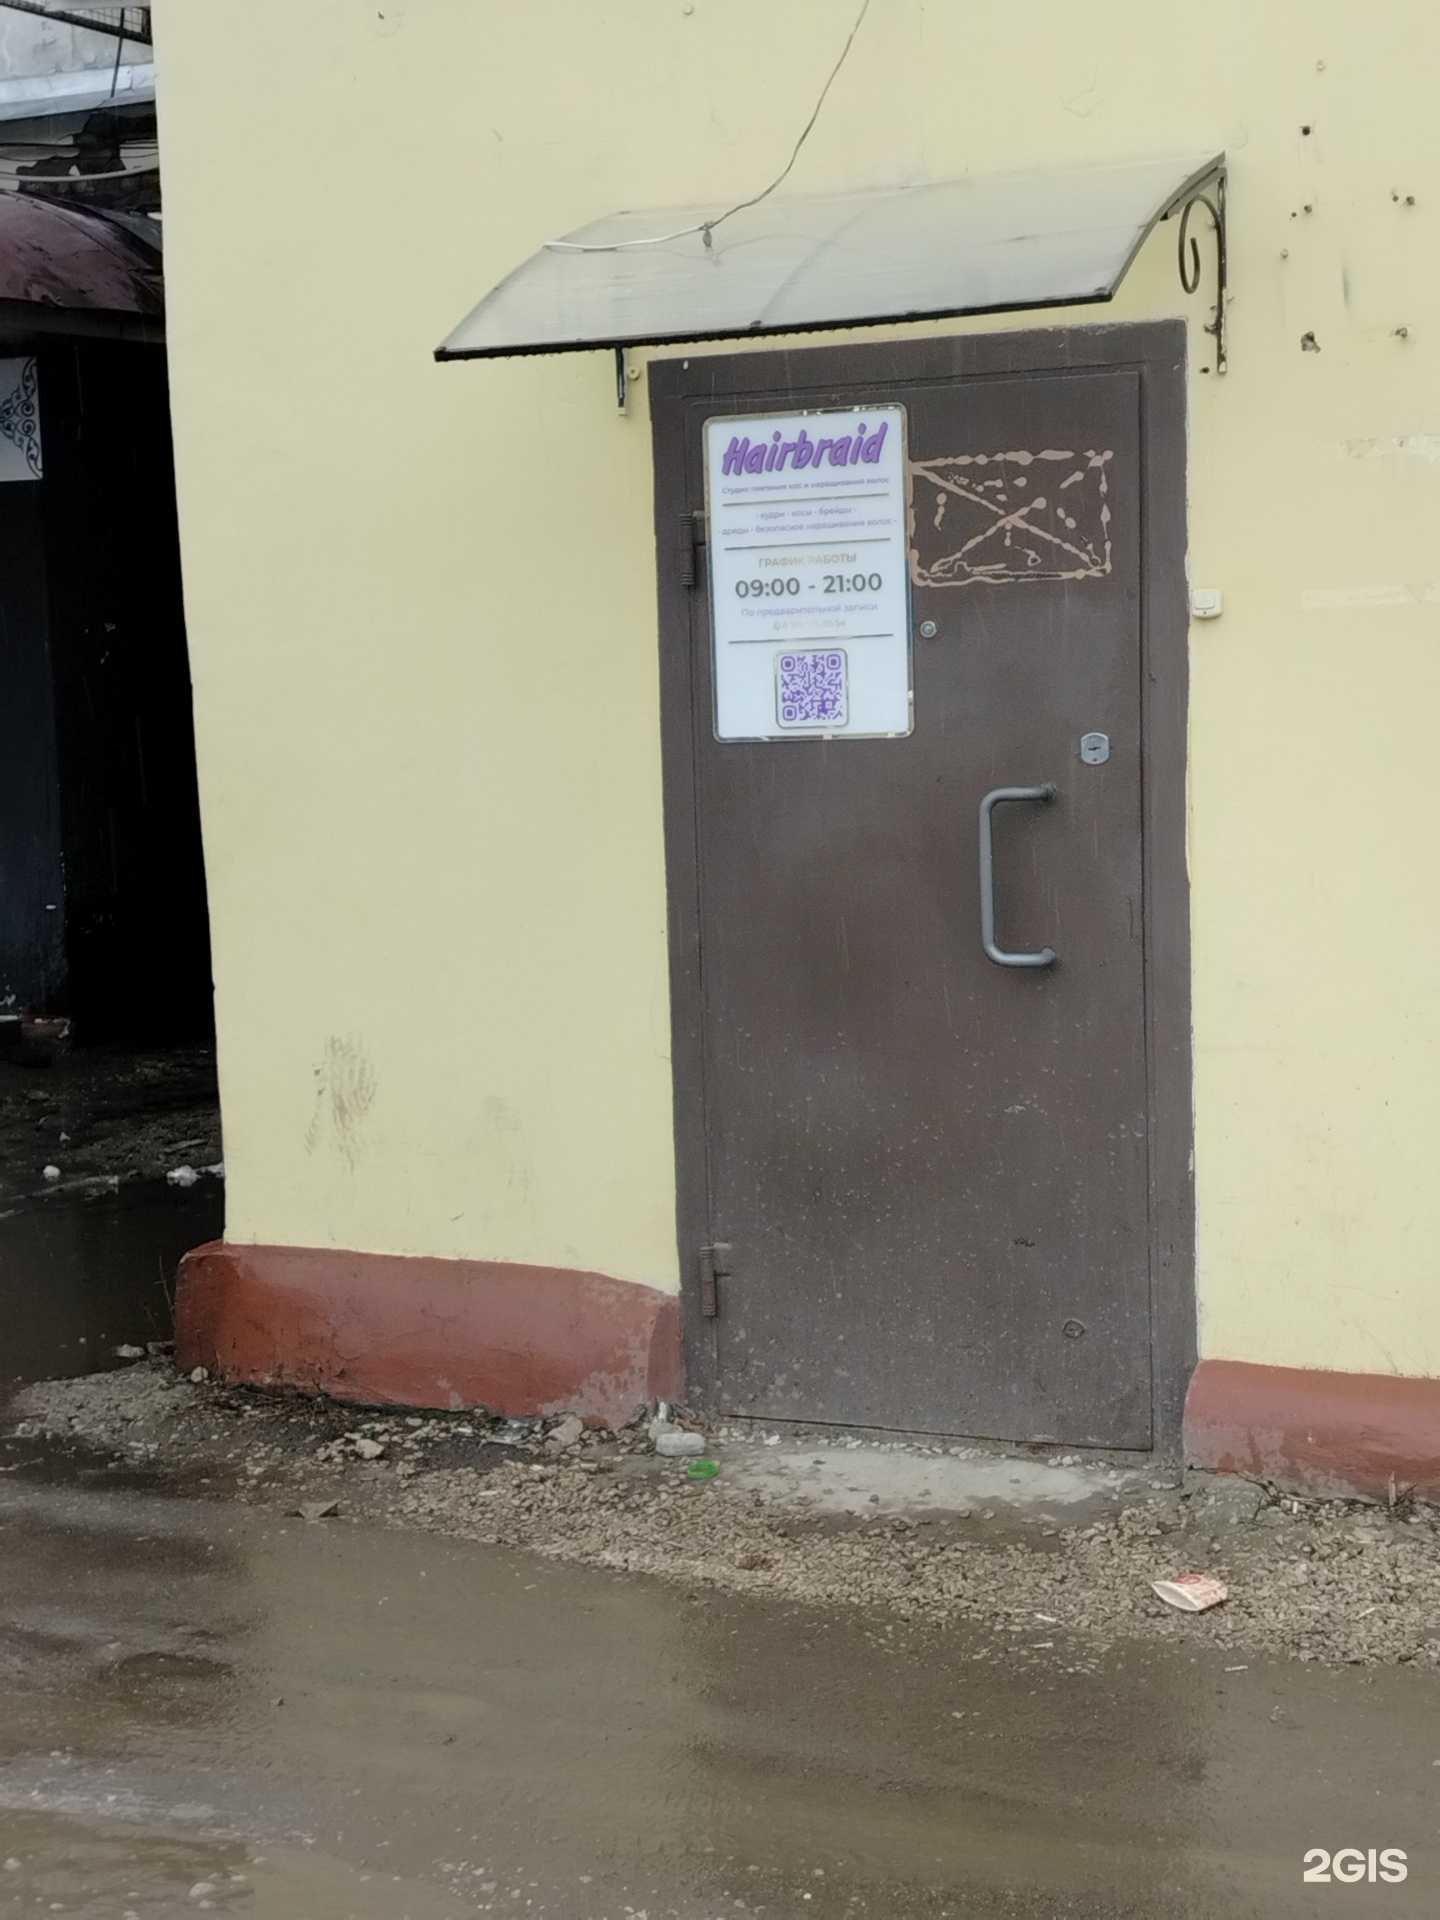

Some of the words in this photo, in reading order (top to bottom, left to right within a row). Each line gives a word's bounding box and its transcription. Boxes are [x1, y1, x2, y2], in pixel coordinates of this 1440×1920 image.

[722, 422, 888, 476] Hairbraid
[758, 556, 804, 569] ГРАФИК
[808, 552, 857, 565] РАБОТЫ
[735, 577, 800, 598] 09:00
[823, 573, 883, 594] 21:00
